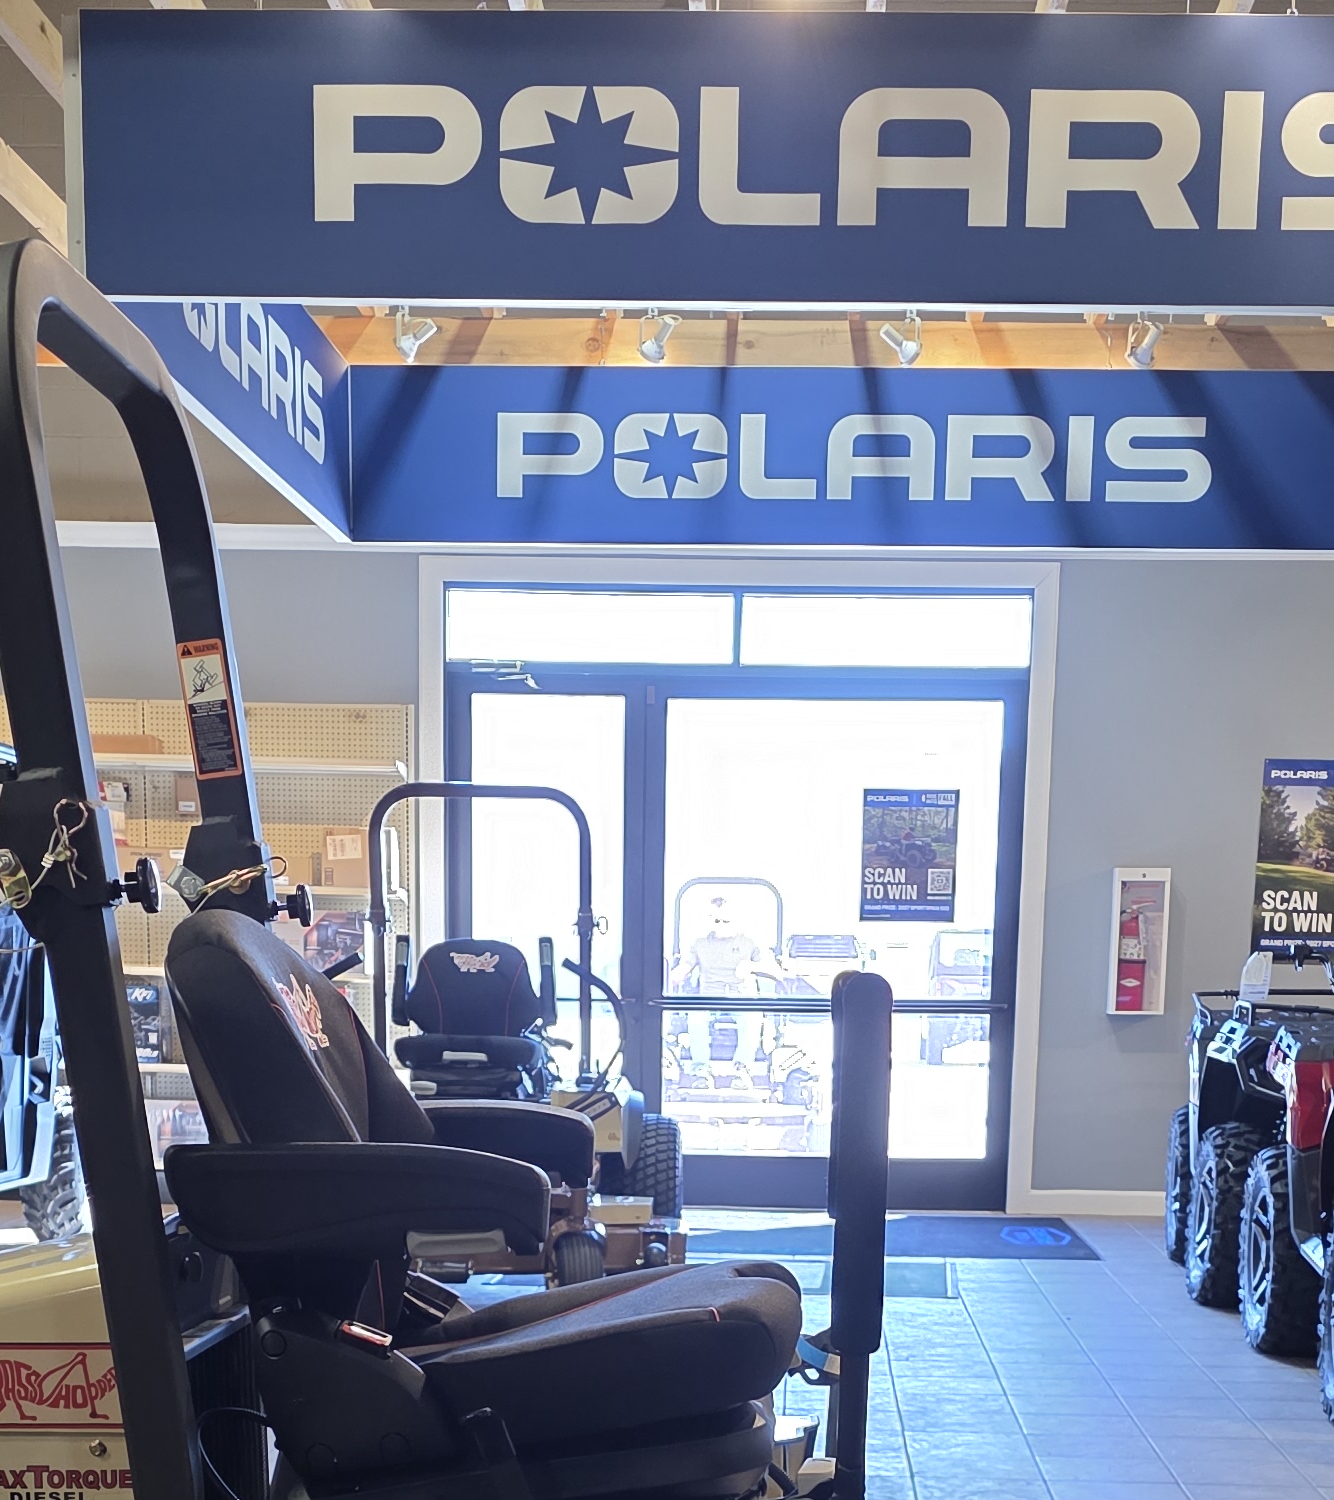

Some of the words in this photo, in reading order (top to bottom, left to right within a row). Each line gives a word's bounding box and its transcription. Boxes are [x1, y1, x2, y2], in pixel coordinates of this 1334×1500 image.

[497, 412, 1211, 502] POLARIS
[1271, 770, 1328, 779] POLARIS
[864, 868, 906, 883] SCAN
[864, 884, 884, 899] TO
[887, 885, 917, 900] WIN
[1262, 890, 1318, 910] SCAN
[1261, 912, 1287, 932] TO
[1292, 913, 1332, 933] WIN
